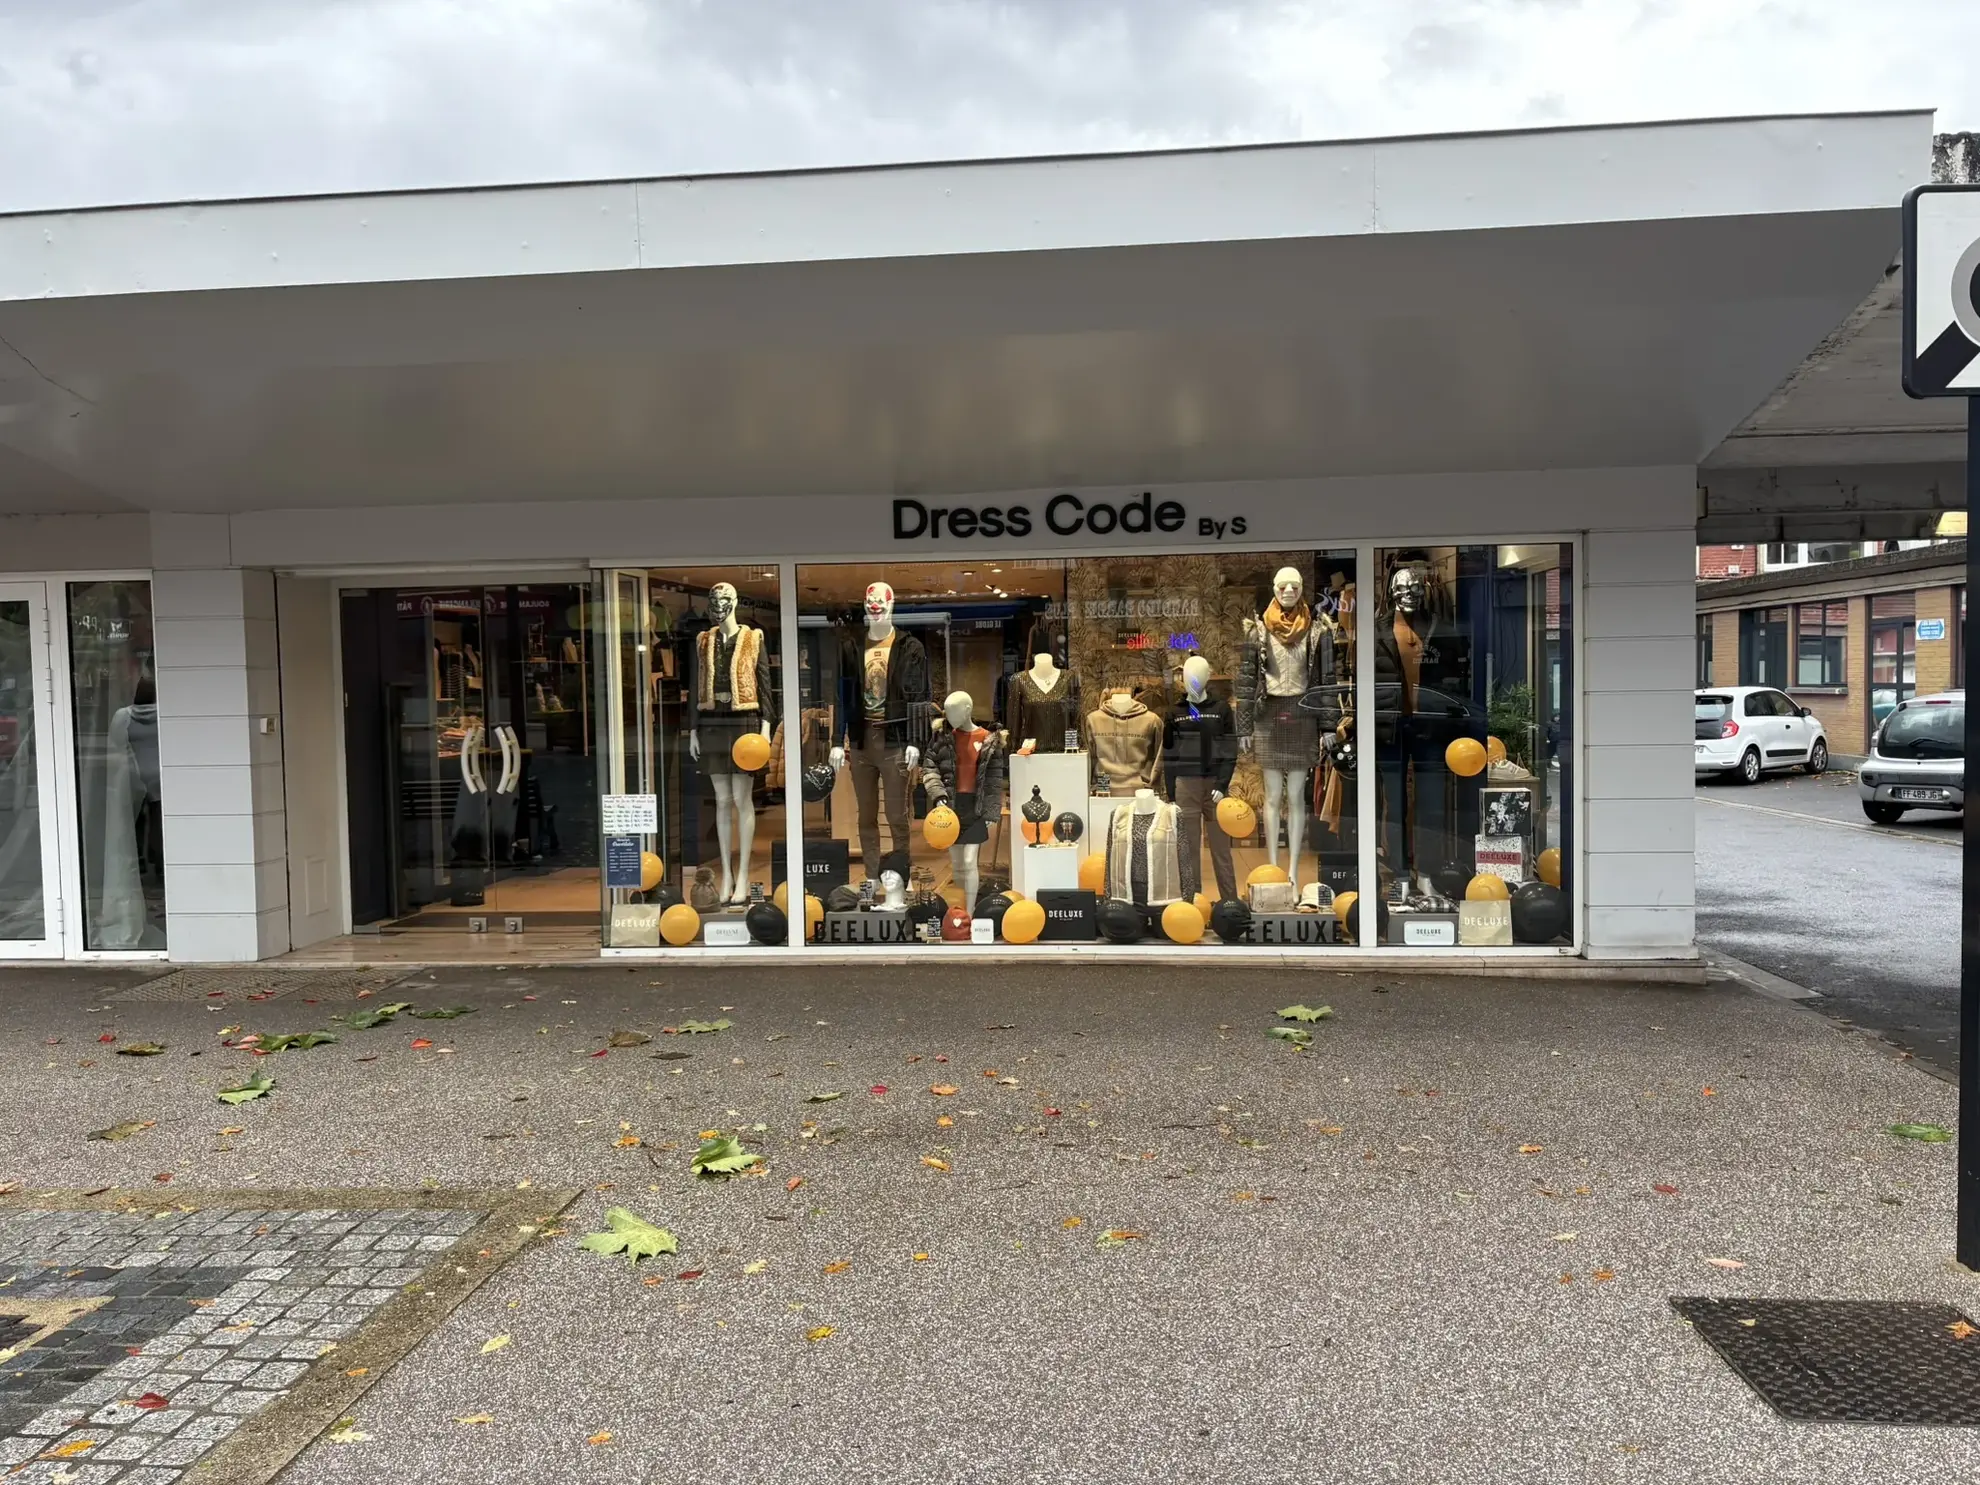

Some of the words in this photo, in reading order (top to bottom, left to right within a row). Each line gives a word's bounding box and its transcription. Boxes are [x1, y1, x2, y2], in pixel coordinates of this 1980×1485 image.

[893, 499, 1032, 540] Dress
[1045, 492, 1186, 536] Code
[1198, 517, 1227, 540] By
[1230, 516, 1248, 536] S
[806, 864, 830, 873] LUXE
[1048, 910, 1083, 918] DEELUXE
[615, 918, 657, 928] DEELUXE
[1464, 916, 1508, 926] DEELUXE
